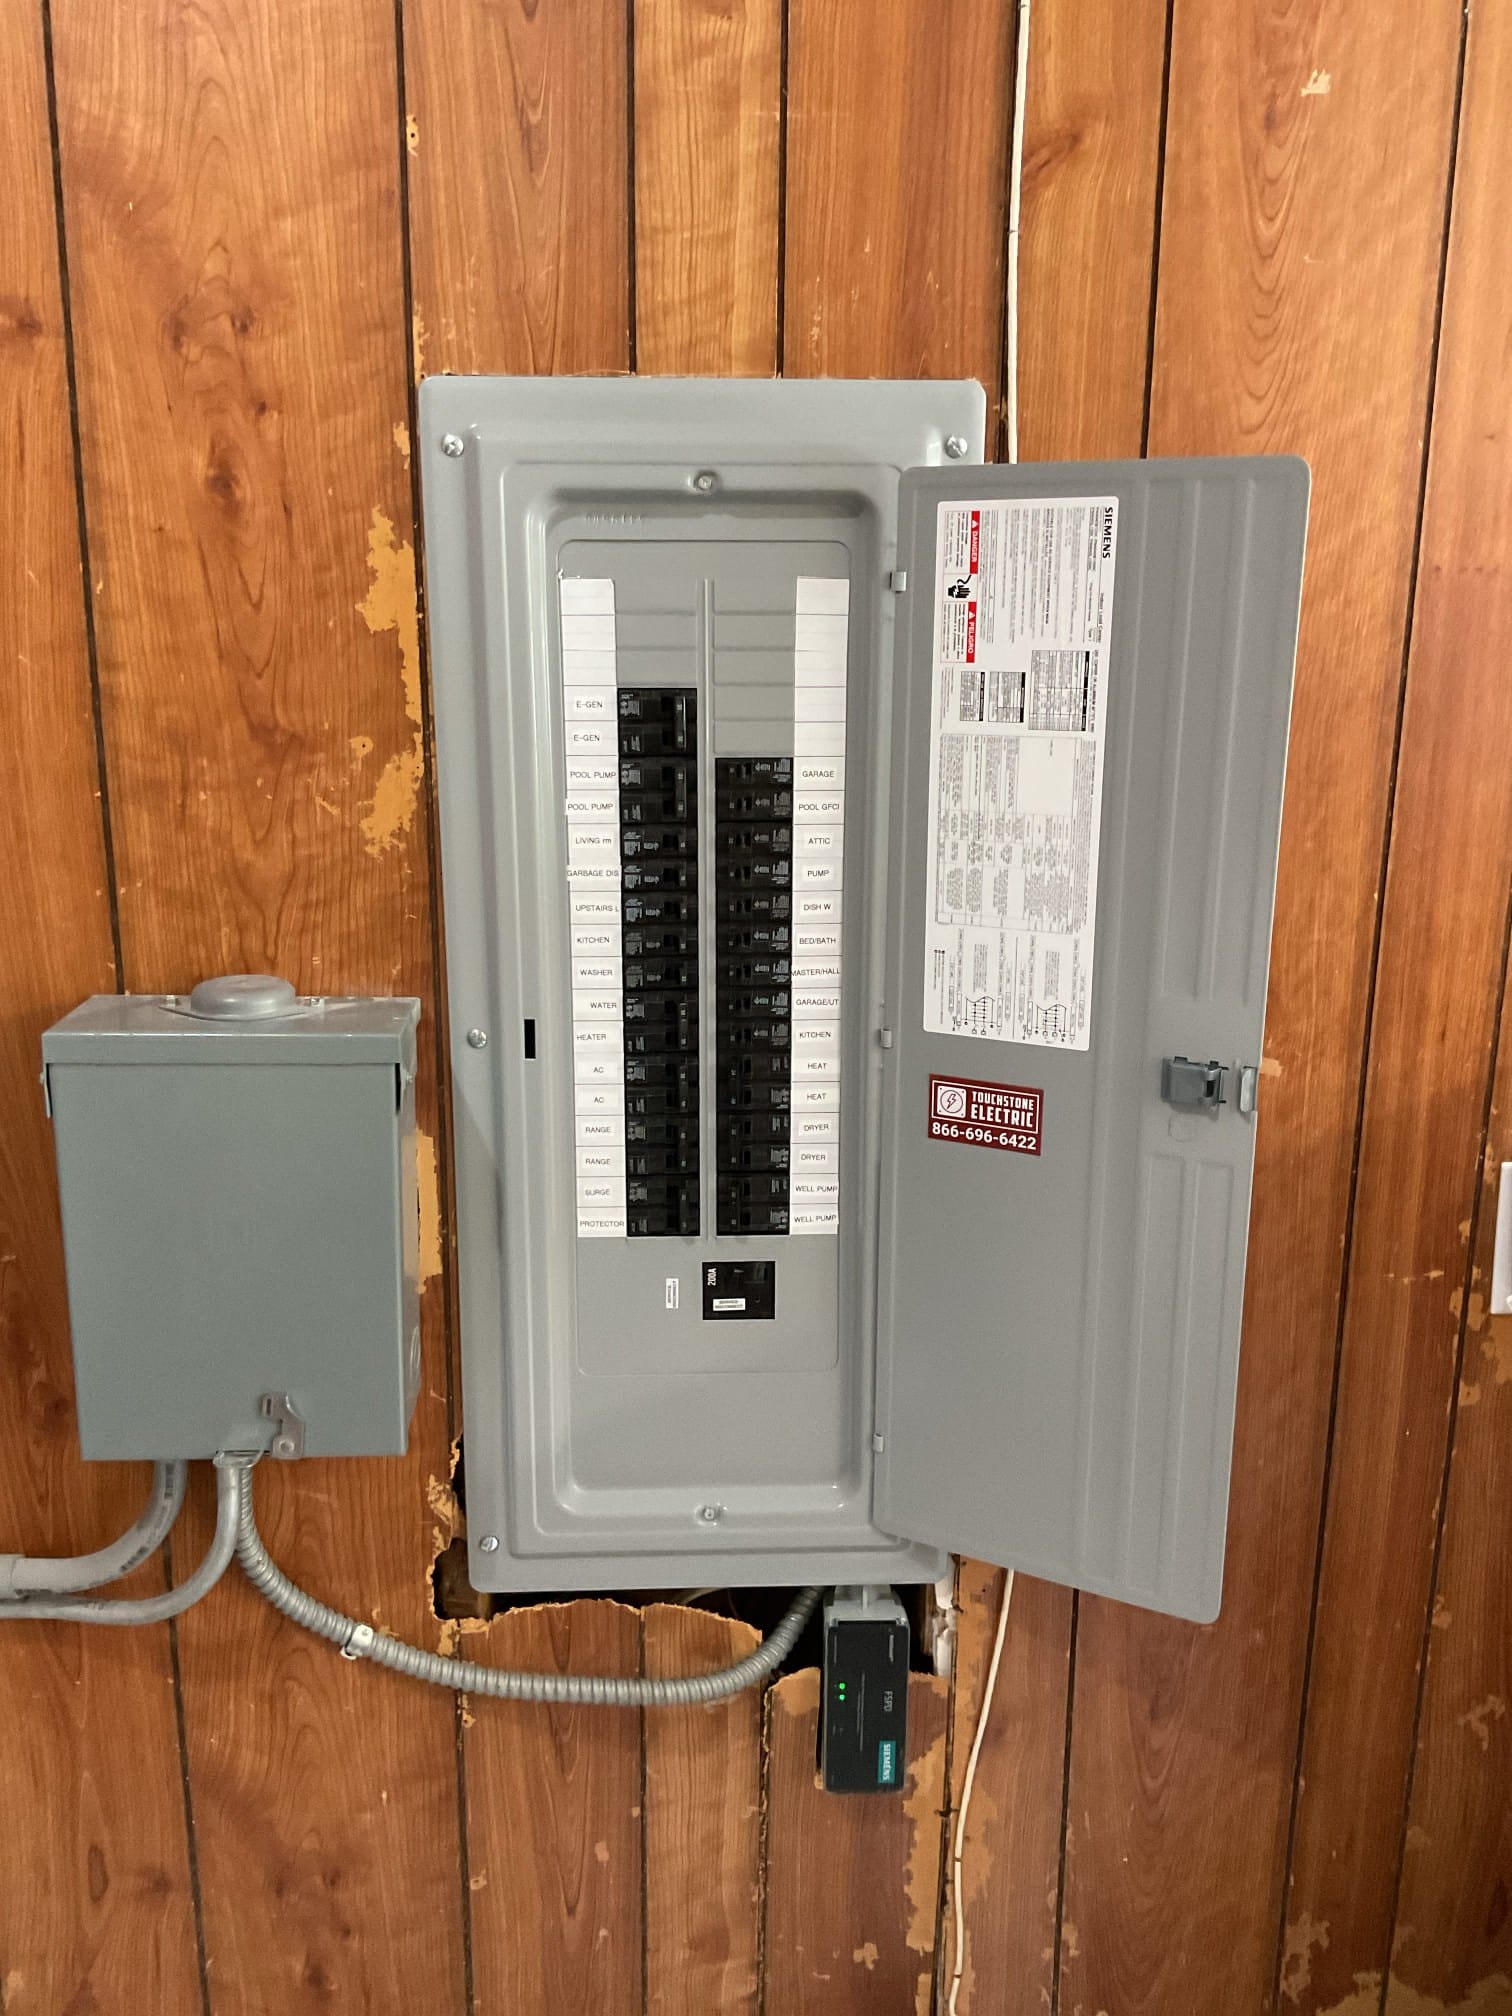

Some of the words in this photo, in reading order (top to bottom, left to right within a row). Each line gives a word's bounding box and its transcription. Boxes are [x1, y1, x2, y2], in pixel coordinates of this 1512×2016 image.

[1102, 506, 1113, 559] SIEMENS
[971, 531, 979, 562] DANGER
[967, 621, 975, 654] PELIGRO
[573, 734, 600, 742] E-GEN
[802, 770, 835, 778] GARAGE
[575, 904, 613, 912] UPSTAIRS
[791, 968, 841, 976] MASTER/HALL
[972, 1091, 1034, 1111] TOUCHSTONE
[971, 1104, 1034, 1127] ELECTRIC
[932, 1122, 1037, 1150] 866-696-6422
[817, 1185, 838, 1193] PUMP
[707, 1268, 717, 1286] 200A
[882, 1743, 891, 1781] SIEMENS
